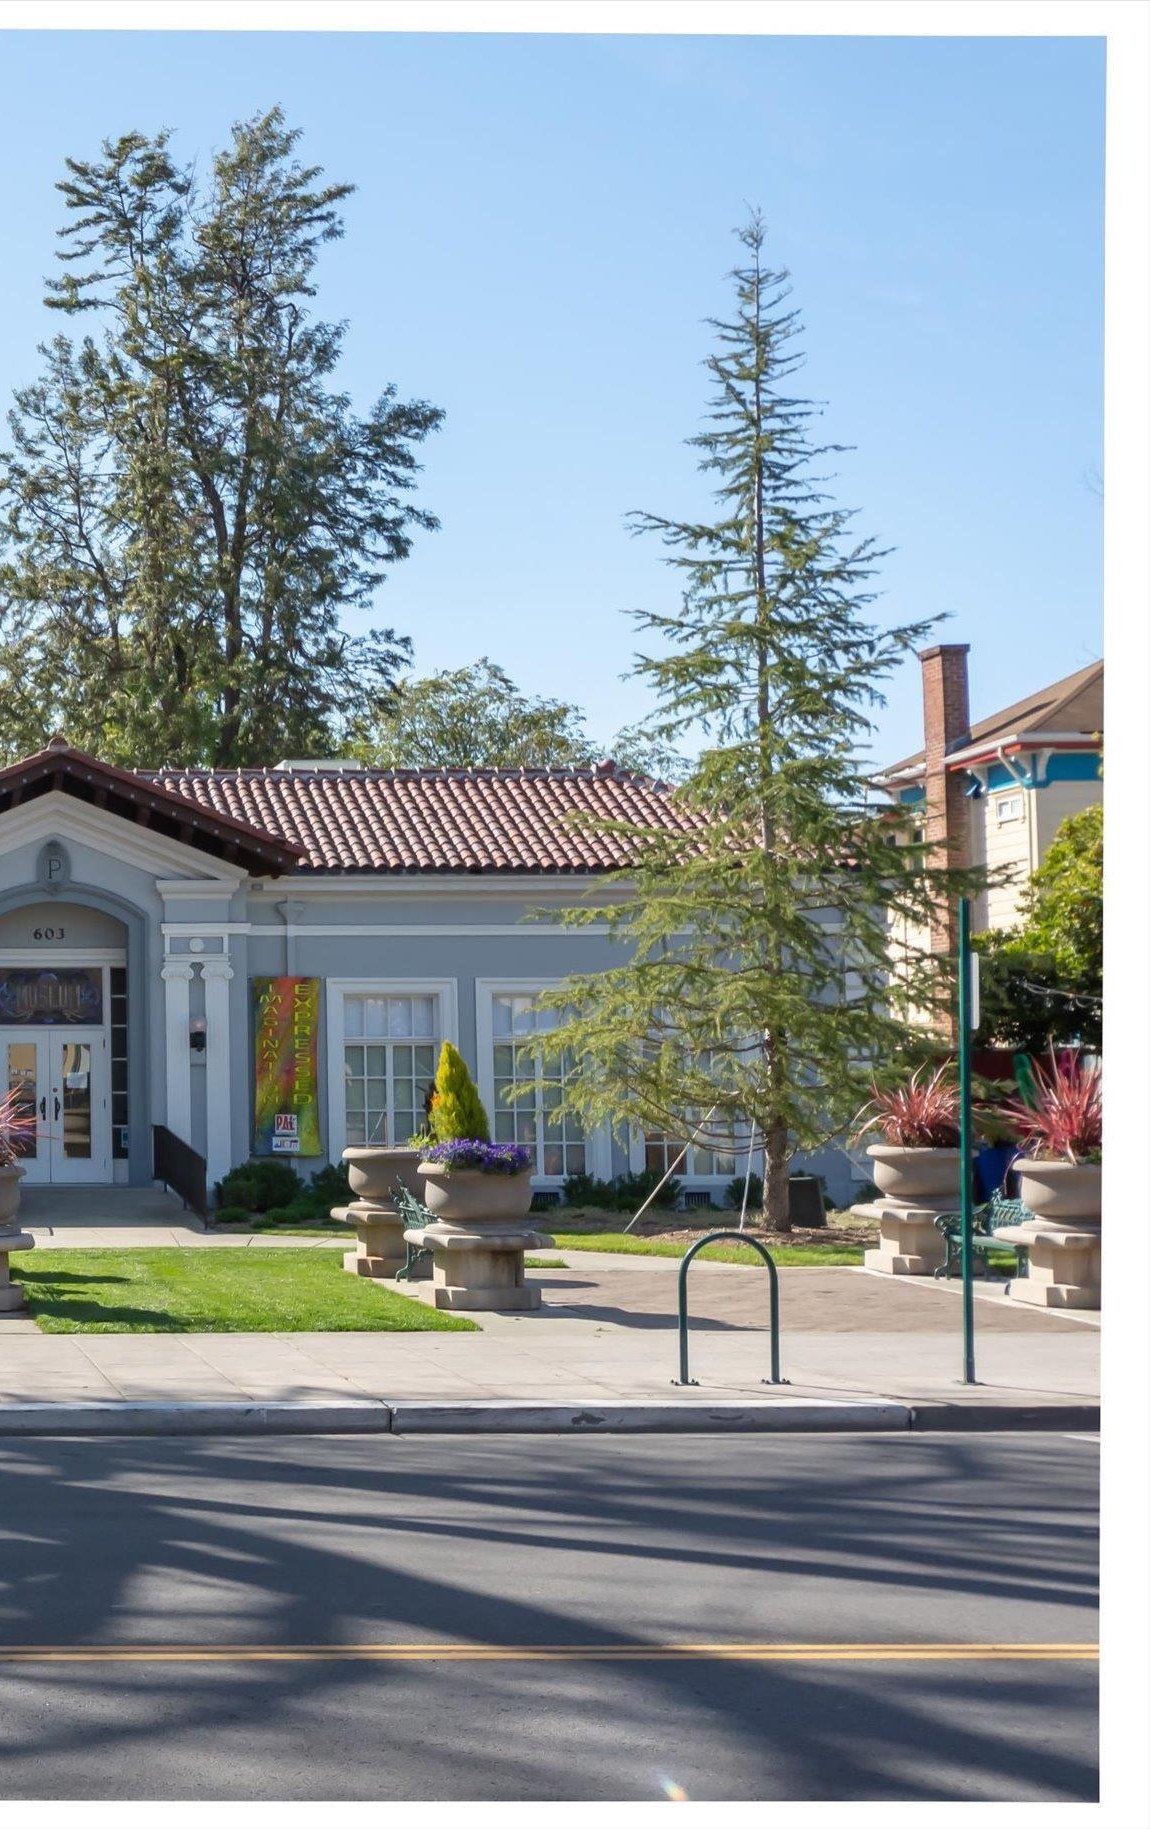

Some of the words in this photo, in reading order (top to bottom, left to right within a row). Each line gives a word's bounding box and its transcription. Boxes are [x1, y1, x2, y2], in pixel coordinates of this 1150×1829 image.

[48, 858, 62, 880] P
[33, 928, 66, 940] 603
[293, 984, 313, 1105] EXPRESSED
